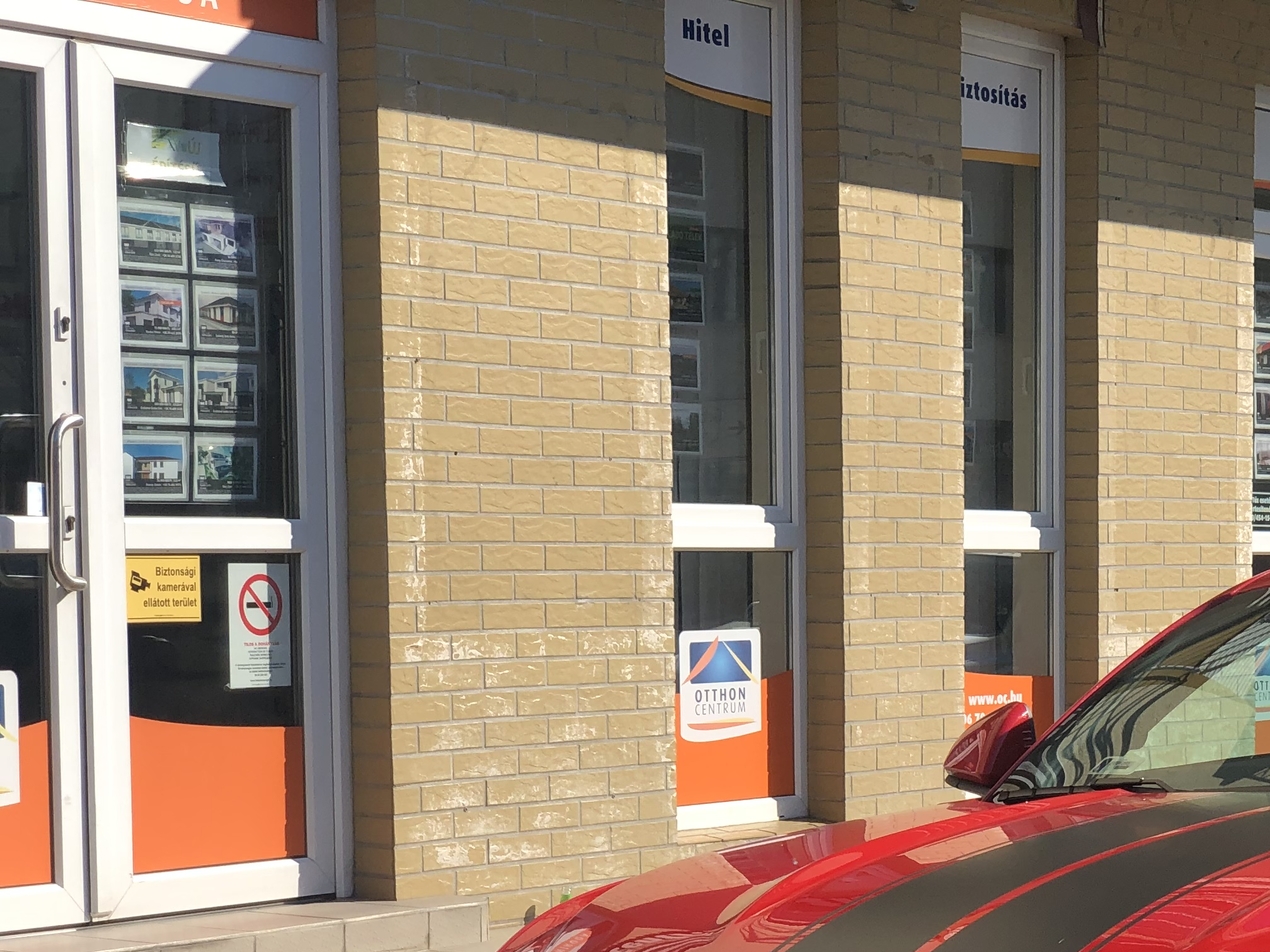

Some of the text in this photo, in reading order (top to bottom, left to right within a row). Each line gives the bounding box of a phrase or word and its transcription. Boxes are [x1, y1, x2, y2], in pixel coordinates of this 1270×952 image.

[682, 17, 730, 48] Hitel
[960, 75, 1027, 110] iztosítás
[155, 566, 197, 579] Biztonsági
[156, 582, 197, 592] kamerával
[143, 597, 198, 608] ellátott terület
[694, 687, 746, 703] OTTHON
[968, 690, 1023, 706] www.oc.hu
[694, 702, 746, 716] CENTRUM
